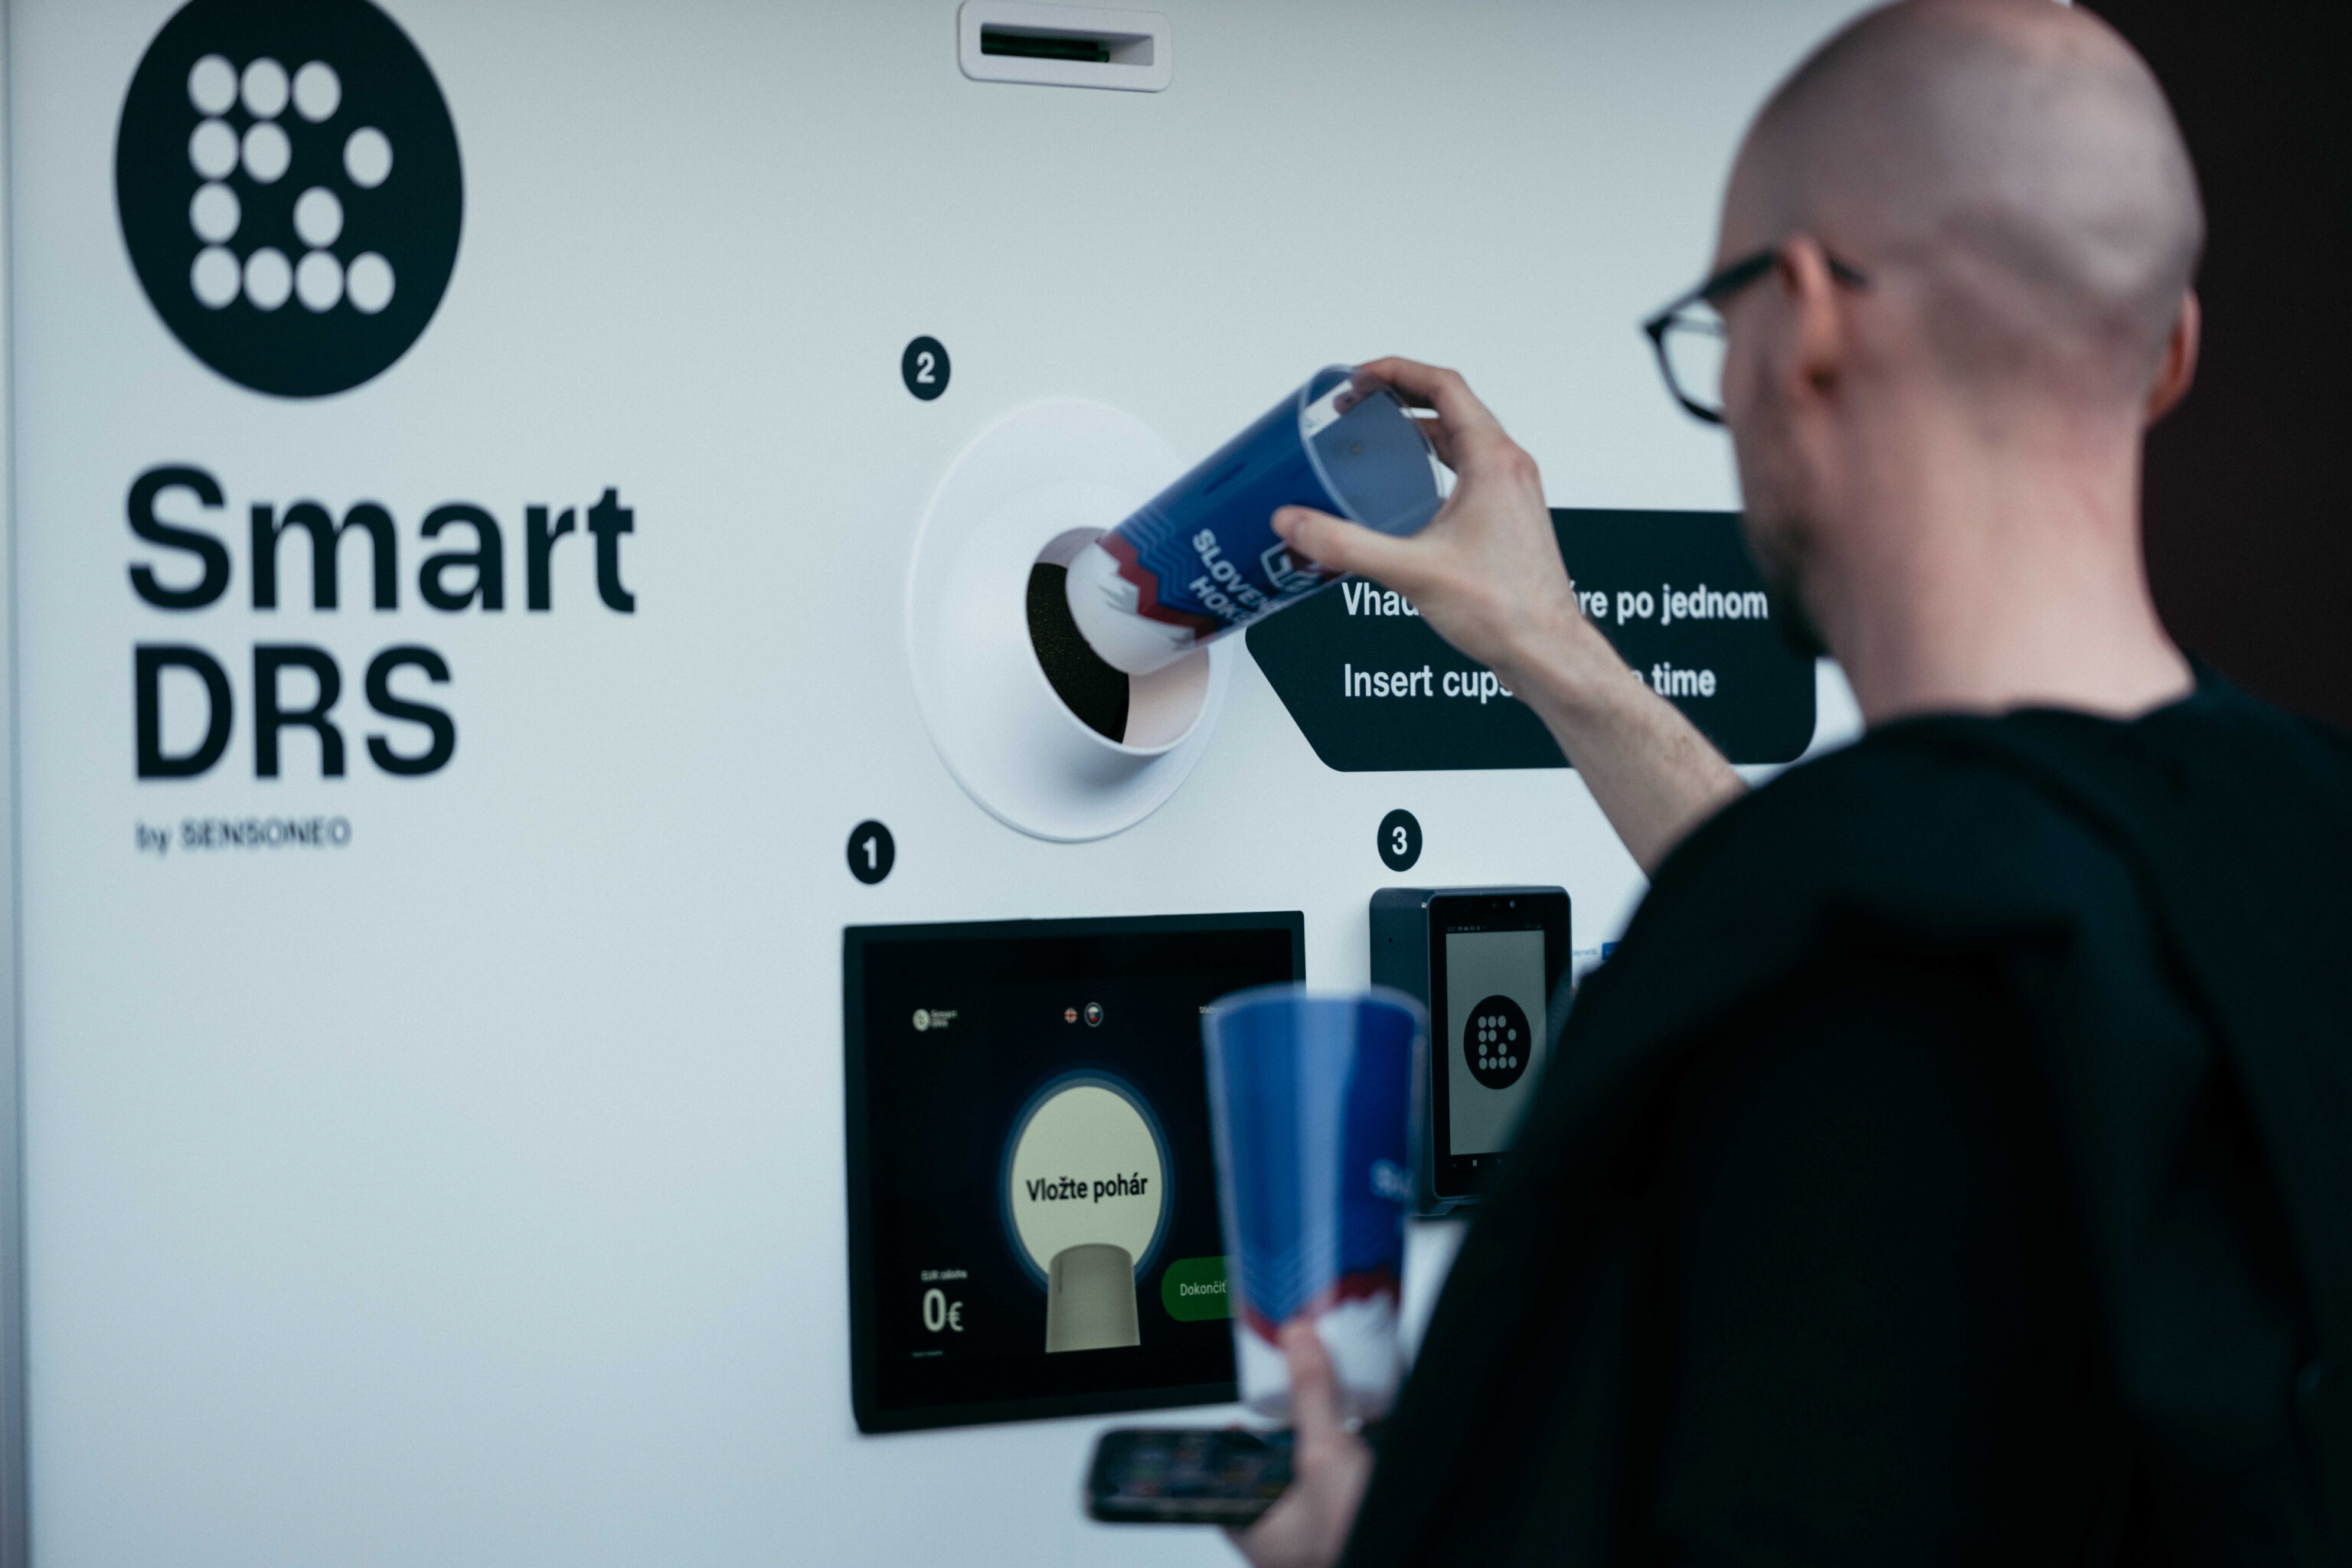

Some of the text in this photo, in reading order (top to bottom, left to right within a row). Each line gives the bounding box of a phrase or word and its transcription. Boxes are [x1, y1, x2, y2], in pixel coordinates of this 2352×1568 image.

[916, 351, 936, 384] 2
[126, 463, 636, 615] Smart
[1617, 591, 1655, 626] po
[1661, 583, 1769, 626] jednom
[1344, 663, 1433, 697] Insert
[1651, 662, 1717, 697] time
[134, 643, 457, 782] DRS
[136, 818, 351, 855] by SENSONEO
[862, 836, 877, 869] 1
[1392, 826, 1408, 855] 3
[1026, 1171, 1148, 1204] Vložte pohár
